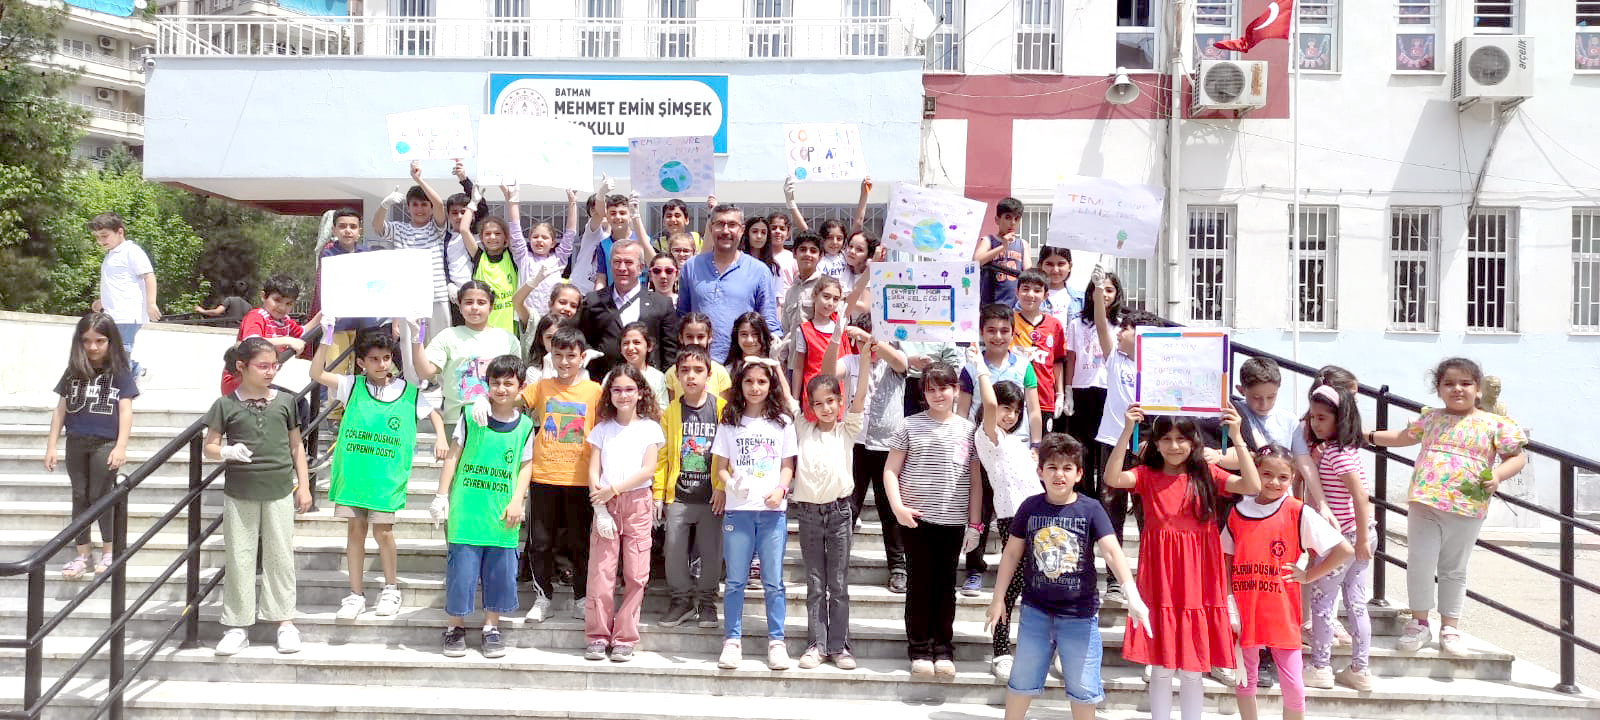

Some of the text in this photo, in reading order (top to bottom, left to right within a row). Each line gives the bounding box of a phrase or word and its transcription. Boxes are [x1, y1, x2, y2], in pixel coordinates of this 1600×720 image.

[1517, 39, 1527, 70] arçelik
[555, 88, 591, 97] BATMAN
[554, 101, 615, 116] MEHMET
[619, 98, 654, 116] EMİN
[658, 97, 712, 118] ŞİMŞEK
[736, 437, 775, 447] STRENGTH
[741, 446, 750, 455] IS
[736, 458, 755, 466] LIGHT
